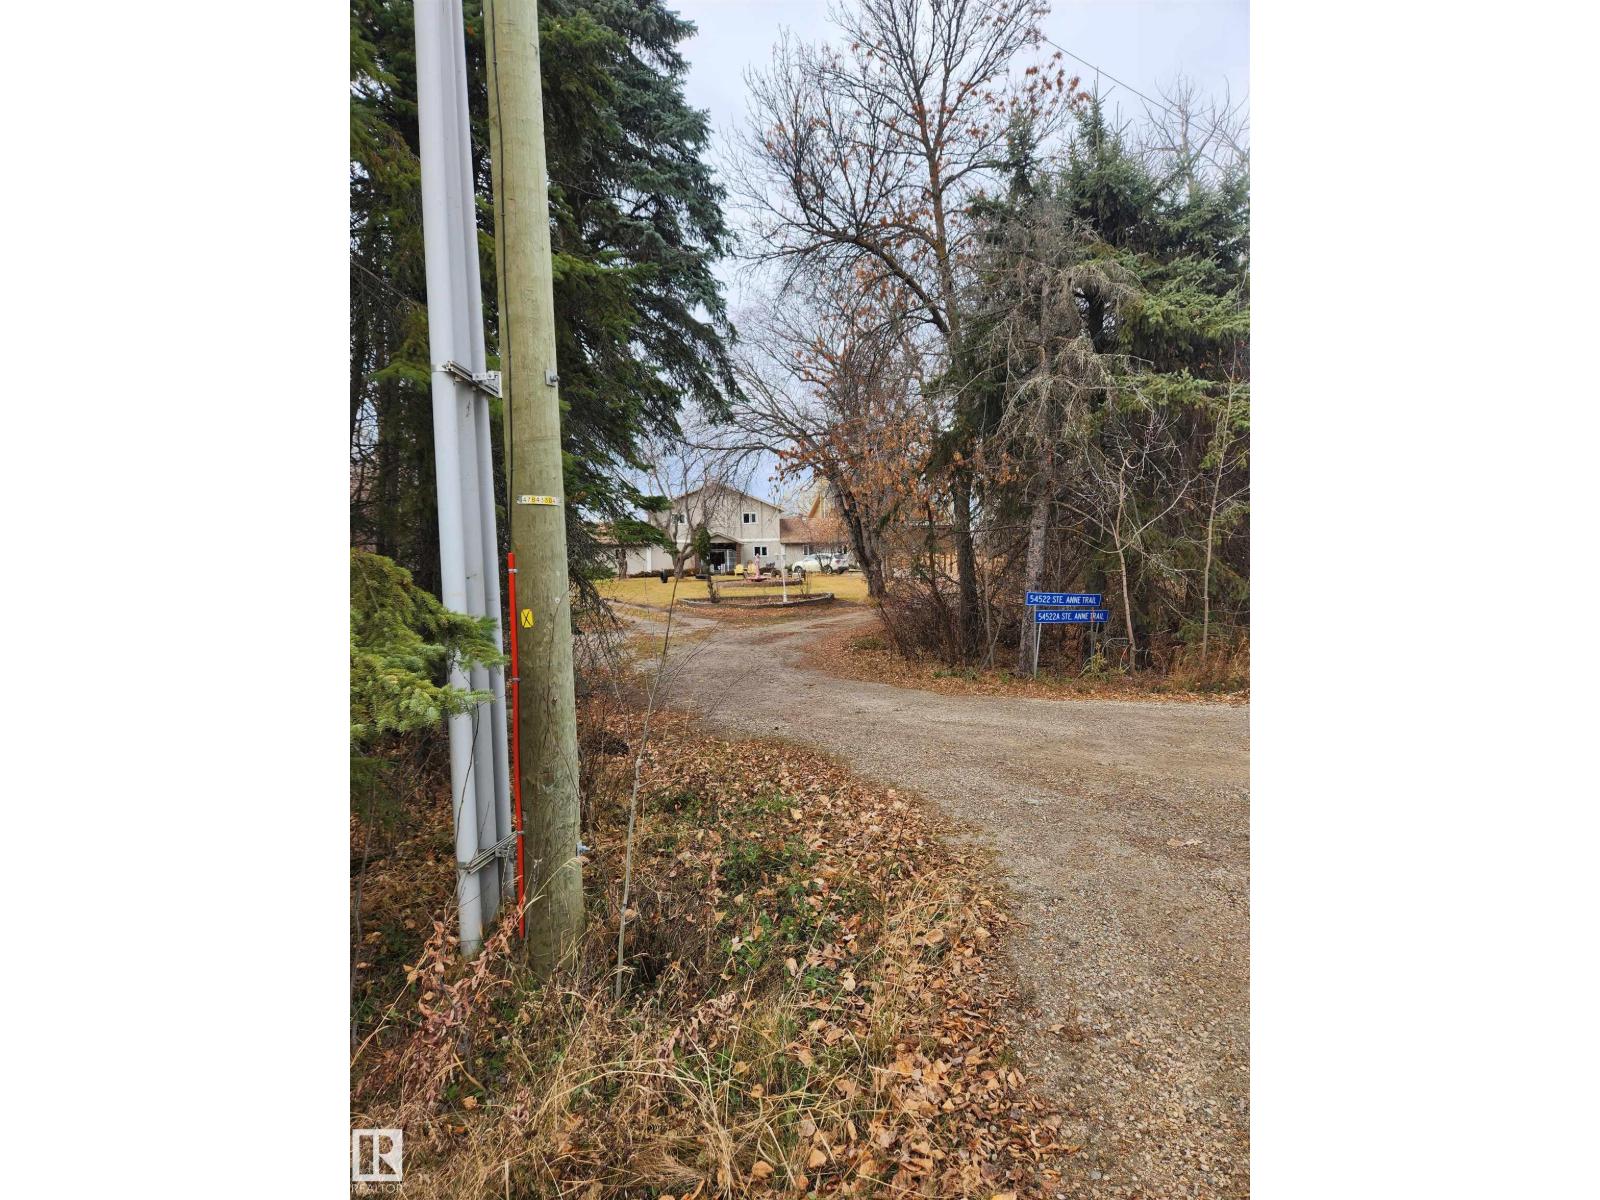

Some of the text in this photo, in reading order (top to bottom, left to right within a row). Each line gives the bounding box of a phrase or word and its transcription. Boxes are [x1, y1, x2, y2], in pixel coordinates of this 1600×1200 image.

[1029, 595, 1051, 604] 54522
[1065, 596, 1081, 604] ANNE
[1082, 596, 1097, 604] TRAIL
[1038, 612, 1060, 621] 54522A
[1074, 612, 1089, 620] ANNE
[1090, 612, 1105, 620] TRAIL
